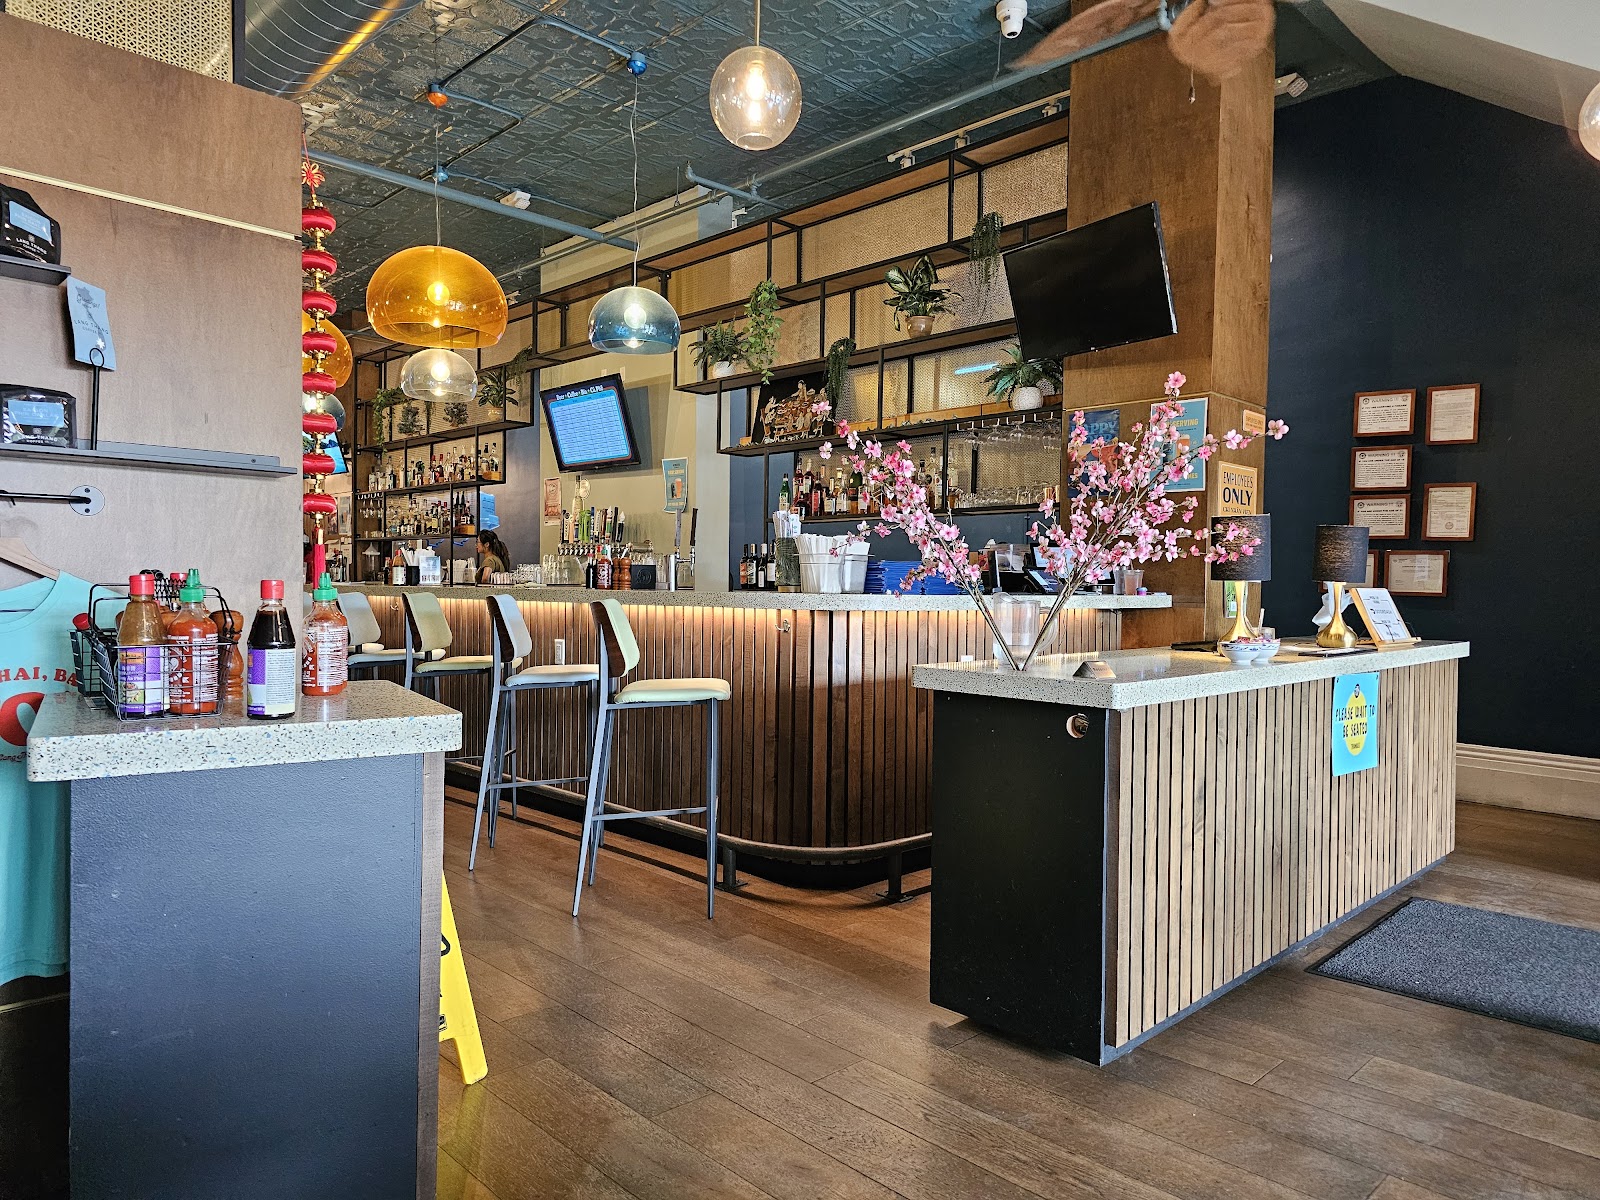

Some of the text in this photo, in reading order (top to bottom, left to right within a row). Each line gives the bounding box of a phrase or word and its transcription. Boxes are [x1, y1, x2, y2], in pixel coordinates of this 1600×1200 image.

[1223, 471, 1253, 489] EMPLOYEES
[1222, 487, 1253, 506] ONLY
[53, 668, 79, 688] BA
[1335, 704, 1376, 721] PLEASE WAIT TO
[1342, 722, 1367, 739] BE SEATED
